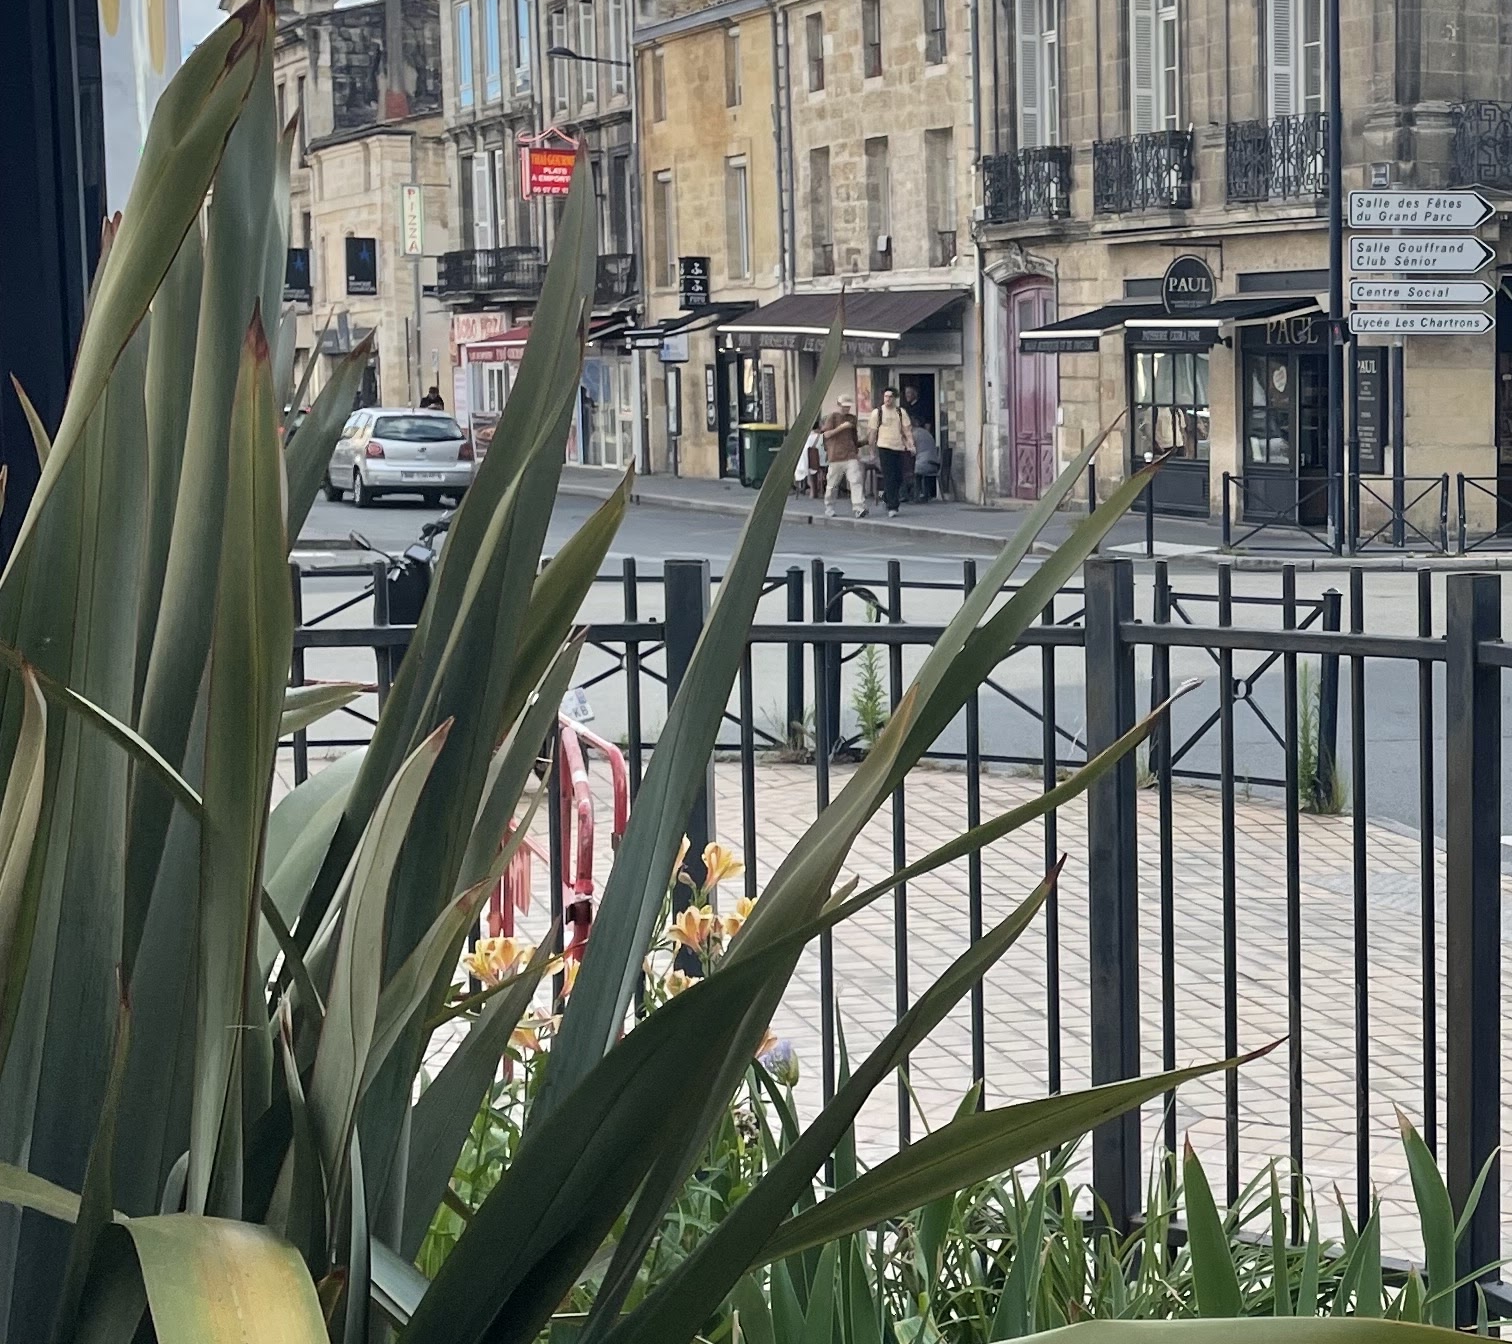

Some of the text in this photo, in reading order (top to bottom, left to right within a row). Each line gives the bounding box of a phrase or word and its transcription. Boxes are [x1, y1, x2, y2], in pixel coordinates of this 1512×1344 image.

[1356, 197, 1462, 209] Salle des Fêtes
[406, 188, 418, 253] PIZZA
[1356, 210, 1453, 222] du Grand Parc
[1356, 241, 1464, 253] Salle Gouffrand
[1356, 255, 1437, 267] Club Sénior
[1168, 277, 1211, 293] PAUL
[1356, 286, 1450, 298] Centre Social
[1356, 317, 1480, 330] Lycée Les Chartrons
[1266, 317, 1319, 345] PAUL
